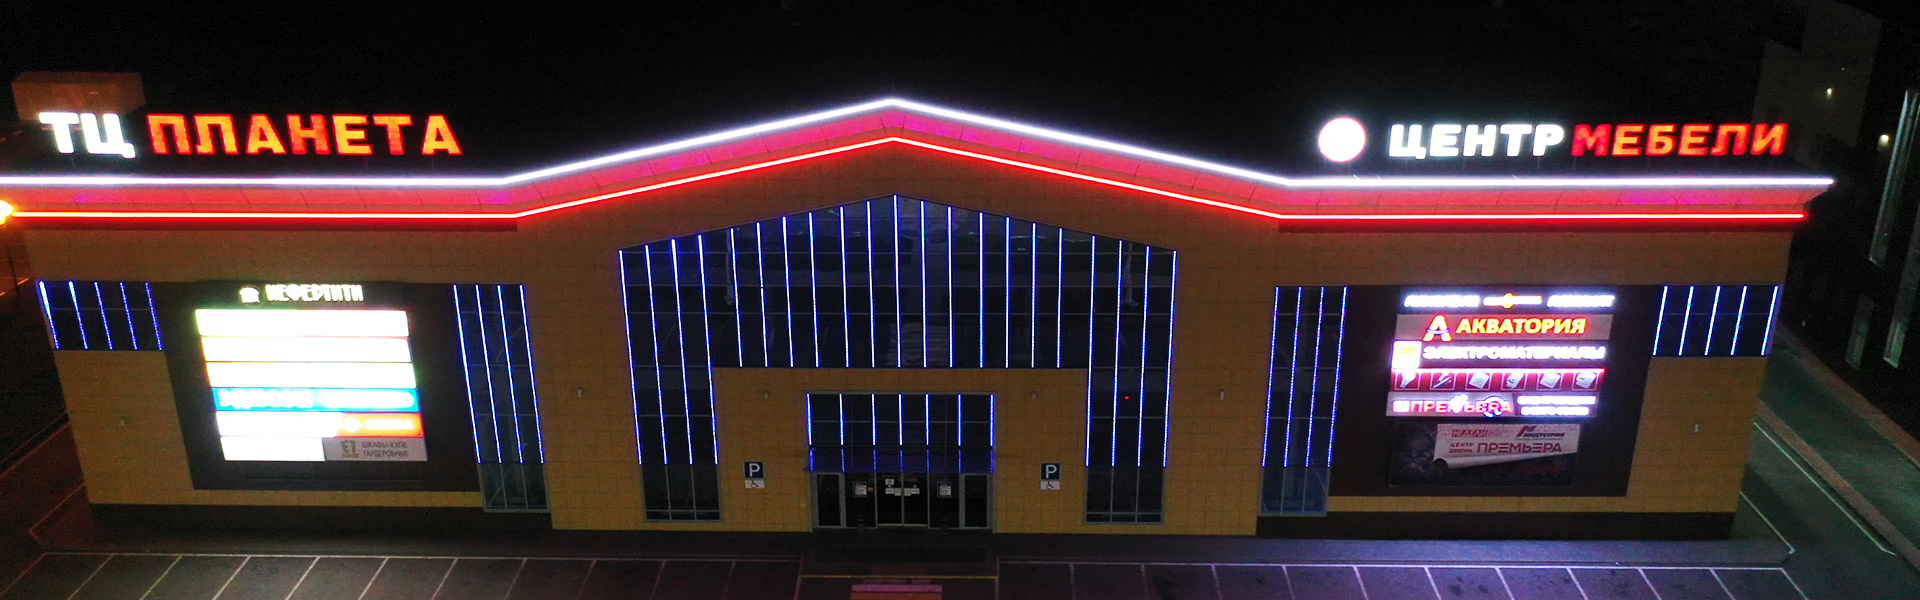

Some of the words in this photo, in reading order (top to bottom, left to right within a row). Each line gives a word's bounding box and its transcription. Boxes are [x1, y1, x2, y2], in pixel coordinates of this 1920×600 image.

[38, 111, 136, 159] ТЦ
[146, 113, 462, 156] ПЛАНЕТА
[1388, 123, 1565, 160] ЦЕНТР
[1571, 122, 1789, 157] МЕБЕЛИ
[265, 284, 364, 302] НЕФЕРТИТИ
[1456, 318, 1587, 334] АКВАТОРИЯ
[1422, 346, 1606, 360] ЭЛЕКТРОМАТЕРИАЛЫ
[1477, 442, 1563, 453] ПРЕМЬЕРА
[749, 463, 760, 477] P
[1045, 464, 1057, 479] P
